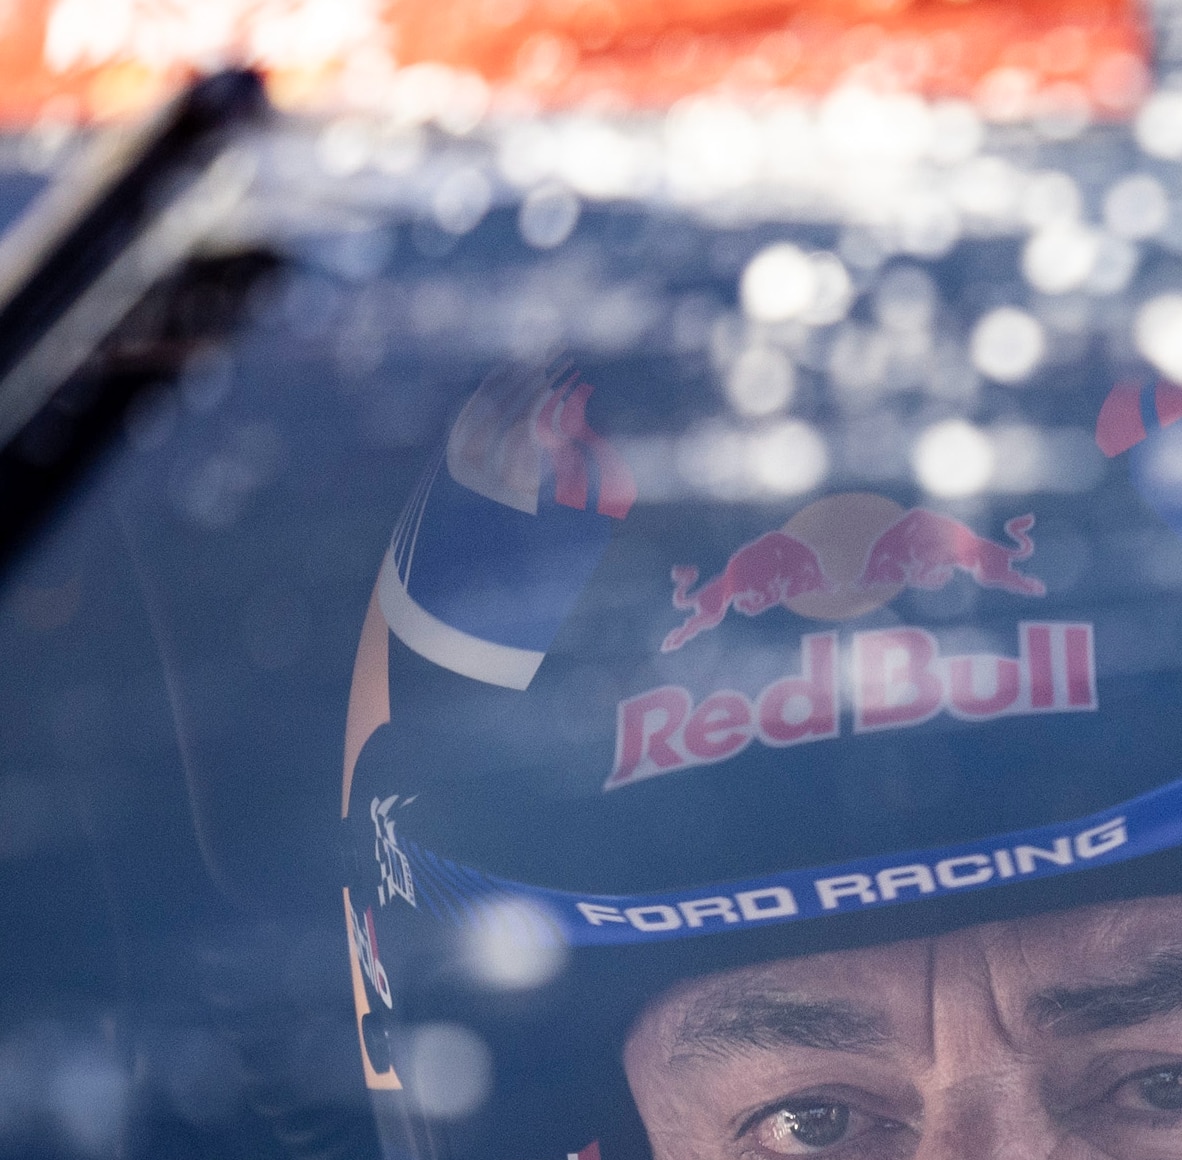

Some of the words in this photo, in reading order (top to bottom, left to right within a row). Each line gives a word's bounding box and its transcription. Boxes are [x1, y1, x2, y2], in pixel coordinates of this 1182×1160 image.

[604, 630, 840, 792] Red
[853, 620, 1098, 734] Bull
[576, 886, 799, 934] FORD
[814, 815, 1128, 910] RACING
